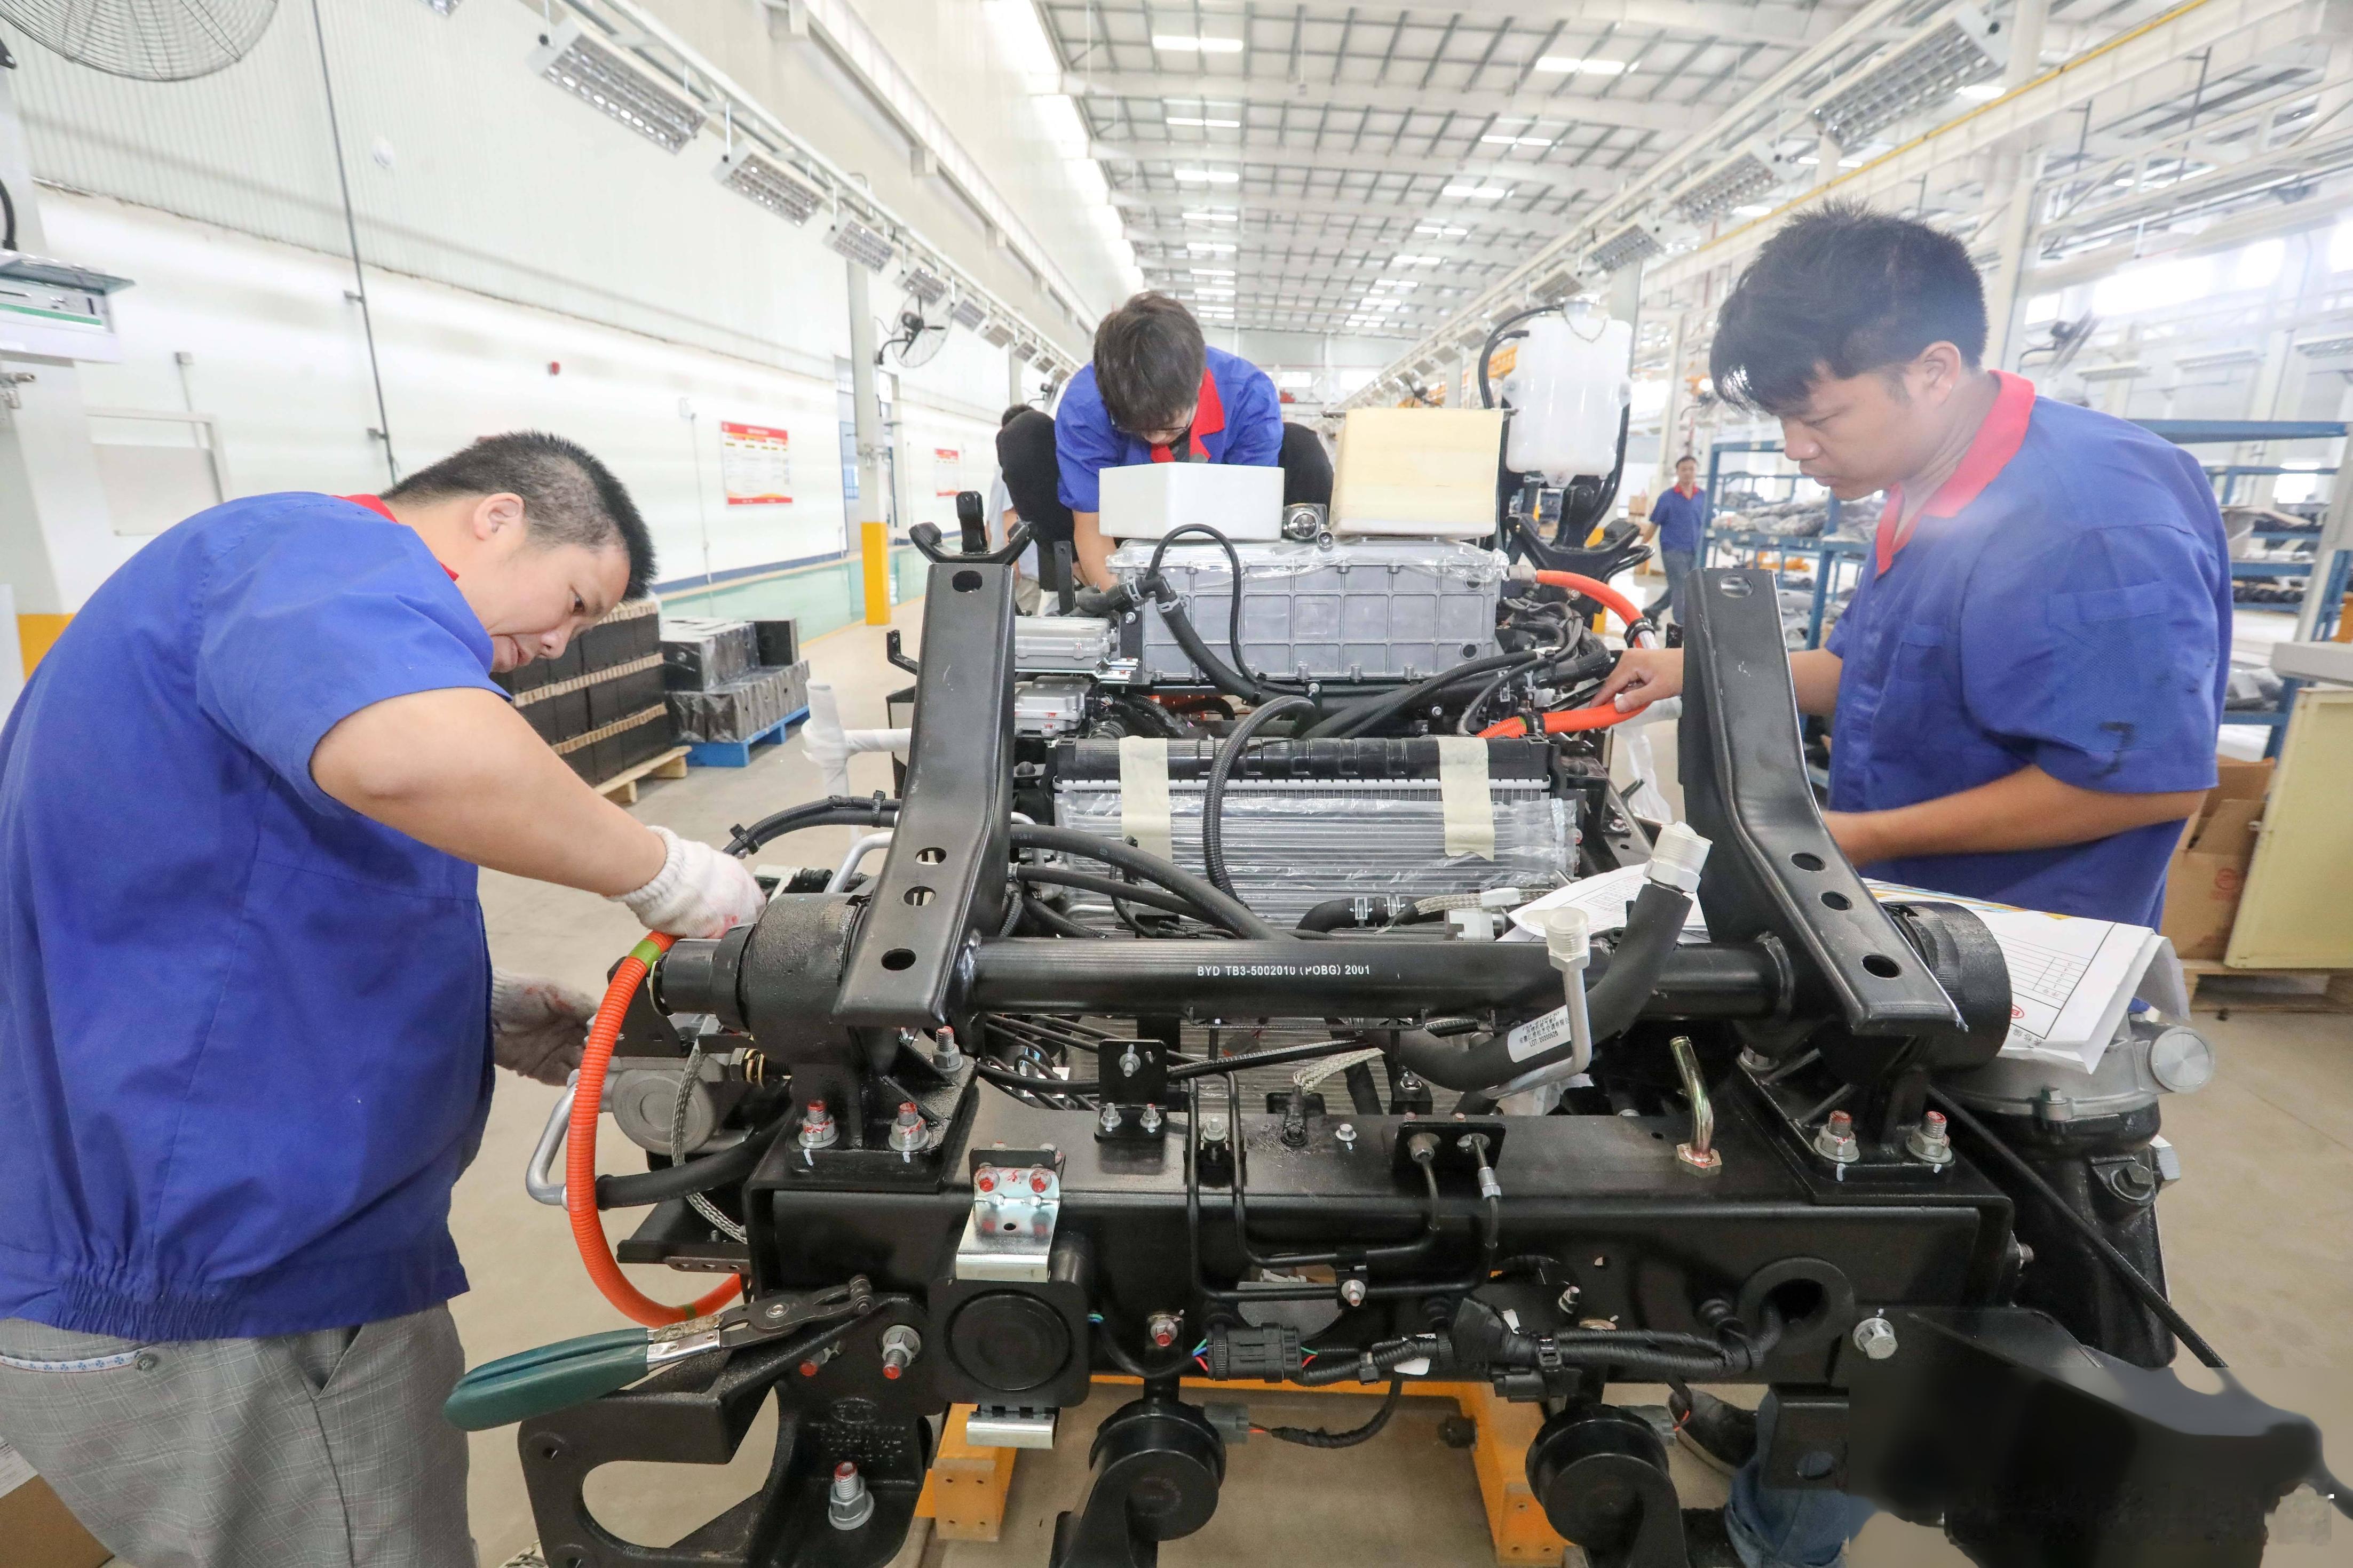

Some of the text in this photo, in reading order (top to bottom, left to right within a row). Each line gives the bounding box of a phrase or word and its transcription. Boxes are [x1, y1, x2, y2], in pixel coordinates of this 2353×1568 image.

[1197, 966, 1220, 976] BYD
[1225, 965, 1296, 976] TB3-5002010
[1345, 964, 1370, 975] 2001
[2010, 1028, 2043, 1046] 表格编
